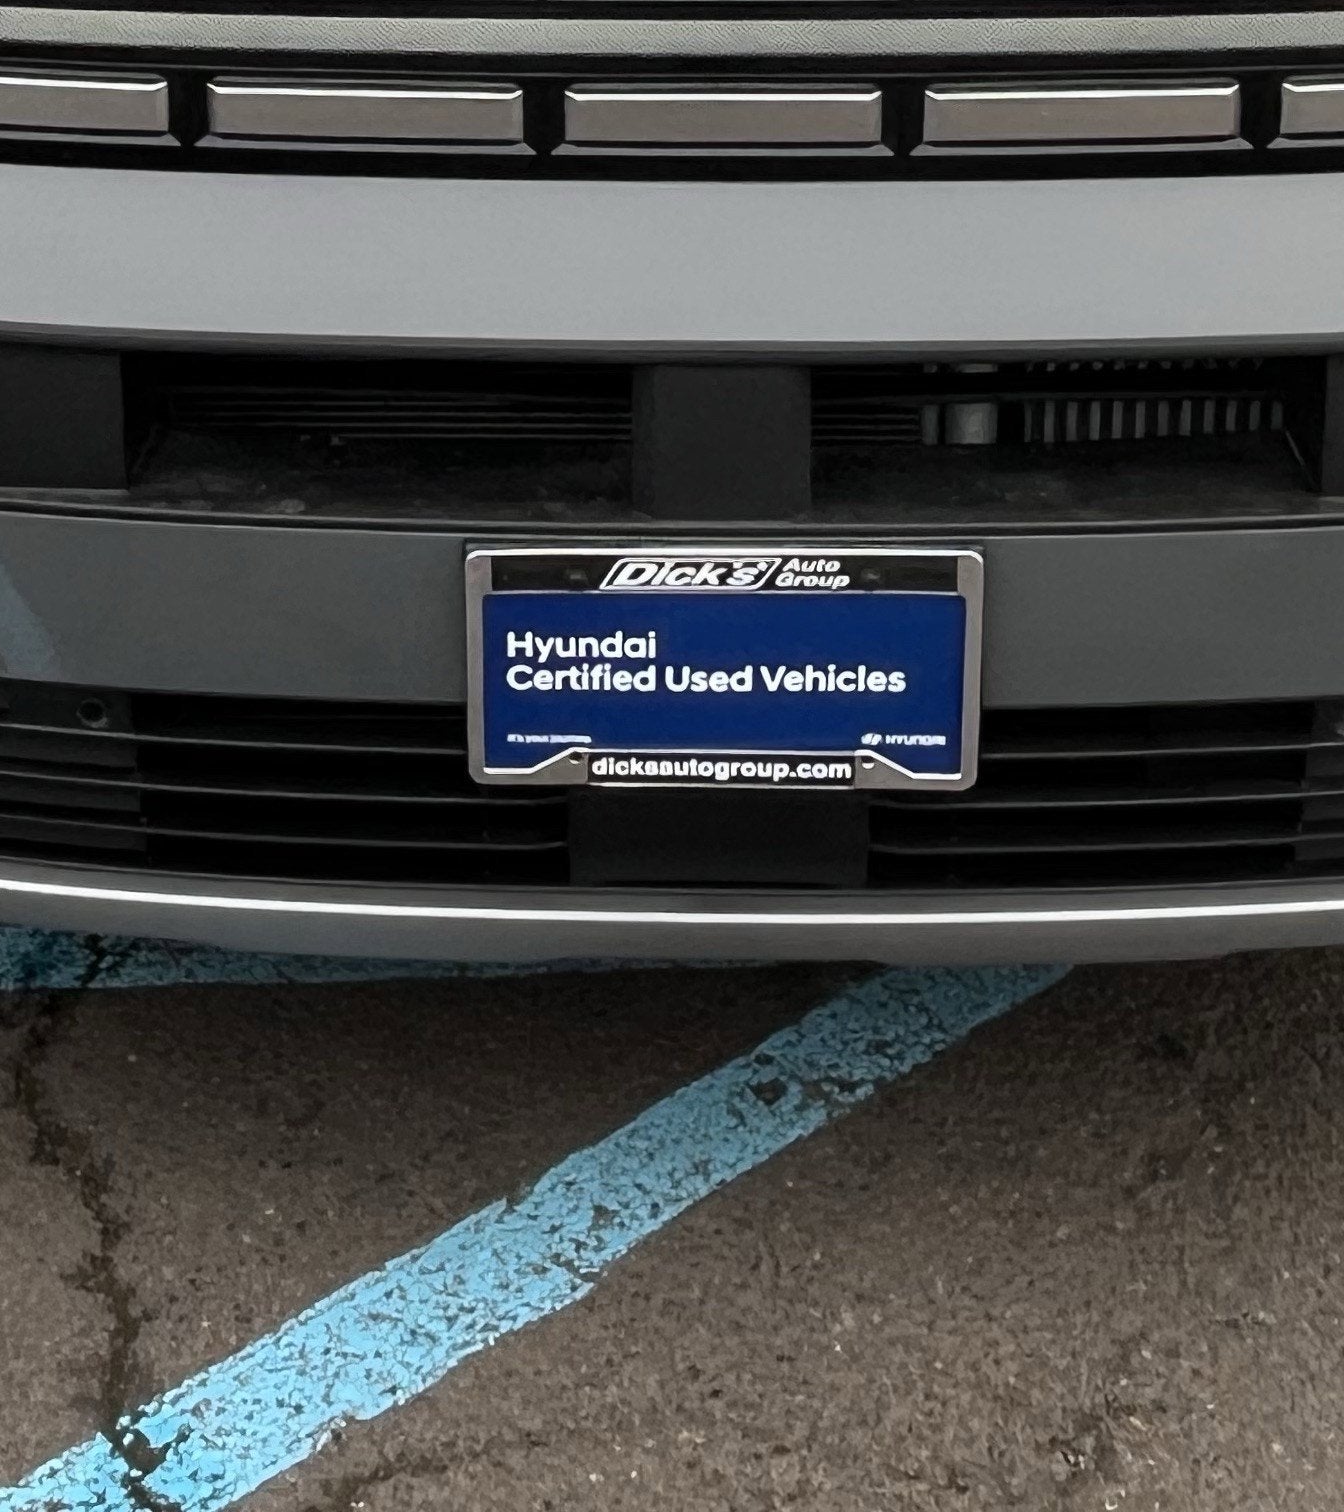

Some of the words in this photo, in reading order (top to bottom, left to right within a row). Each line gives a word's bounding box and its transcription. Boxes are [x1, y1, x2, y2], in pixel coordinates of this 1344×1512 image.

[781, 557, 841, 573] Auto
[774, 574, 851, 590] Group
[506, 631, 657, 663] Hyundai
[506, 663, 657, 692] Certified
[664, 665, 754, 693] Used
[760, 665, 907, 693] Vehicles
